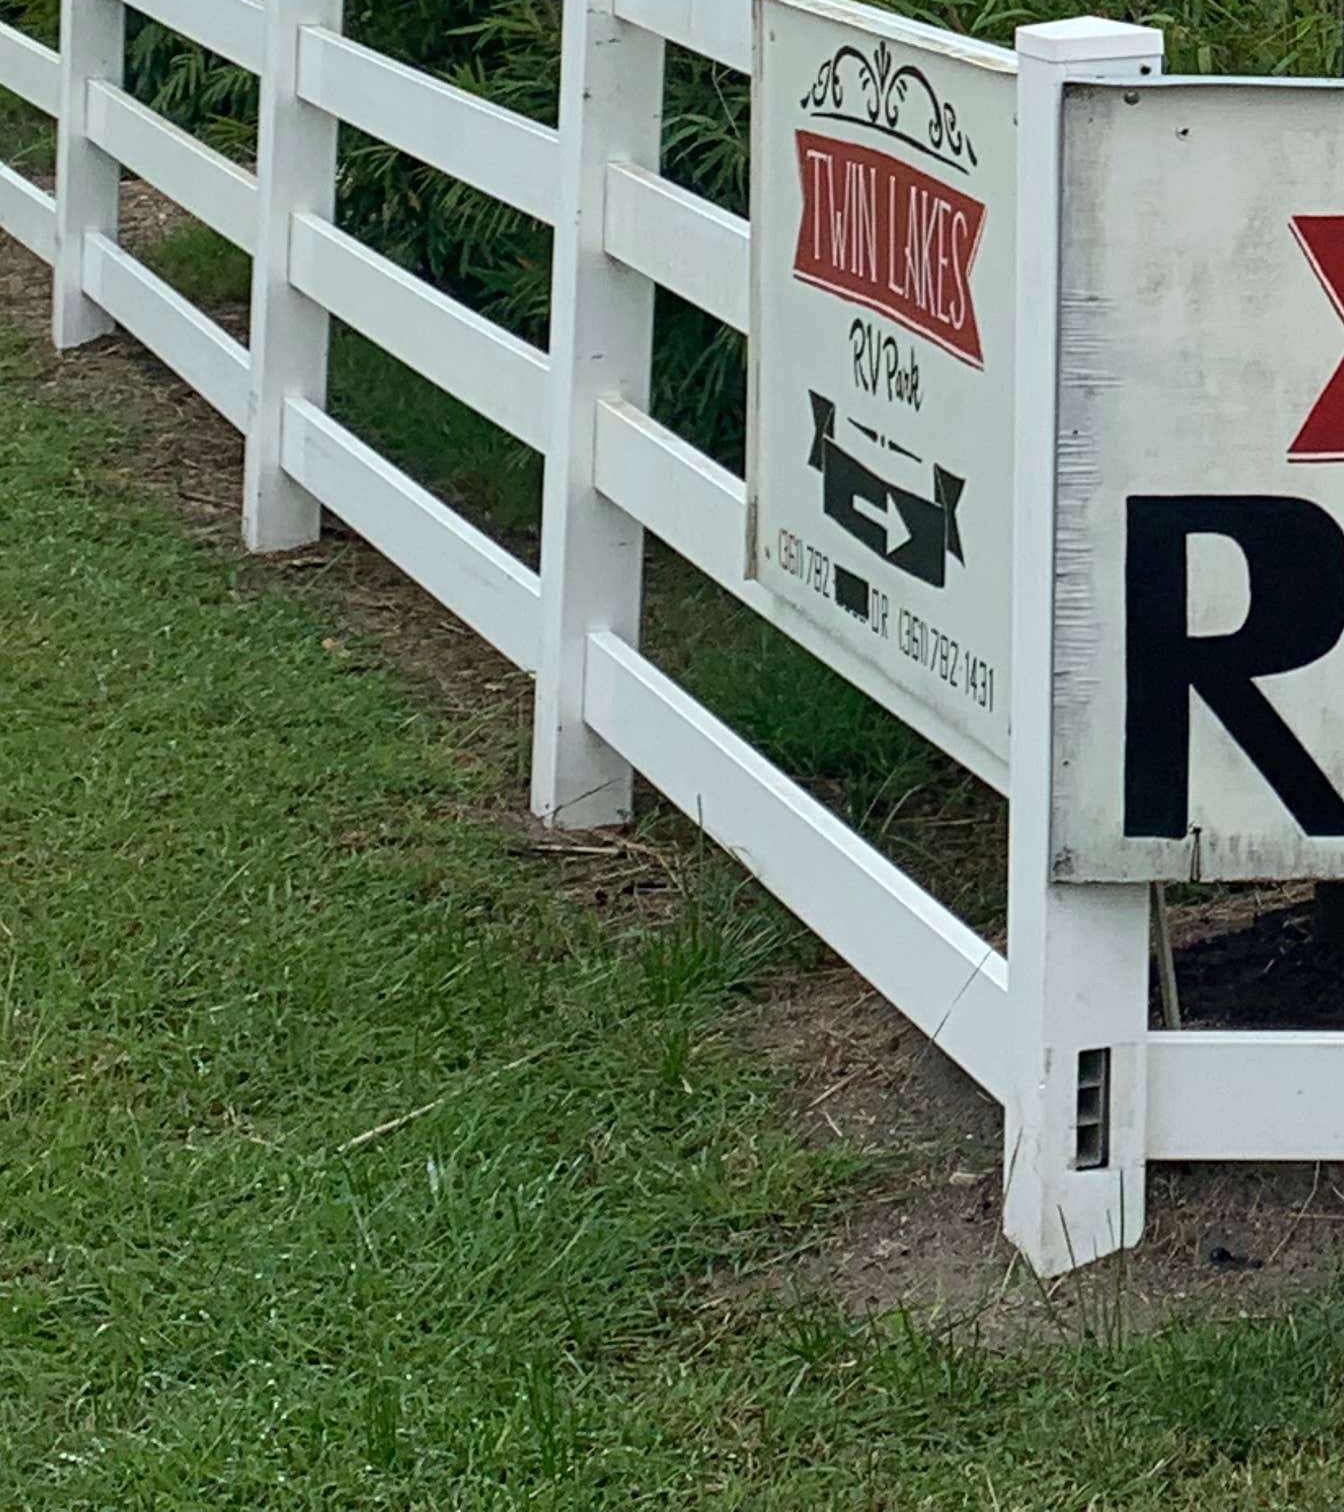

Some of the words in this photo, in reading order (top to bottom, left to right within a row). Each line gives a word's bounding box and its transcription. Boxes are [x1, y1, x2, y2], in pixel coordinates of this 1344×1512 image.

[806, 149, 877, 283] TWIN
[888, 175, 968, 330] LAKES
[849, 317, 882, 397] RV
[882, 335, 925, 413] Park
[871, 588, 889, 640] OR
